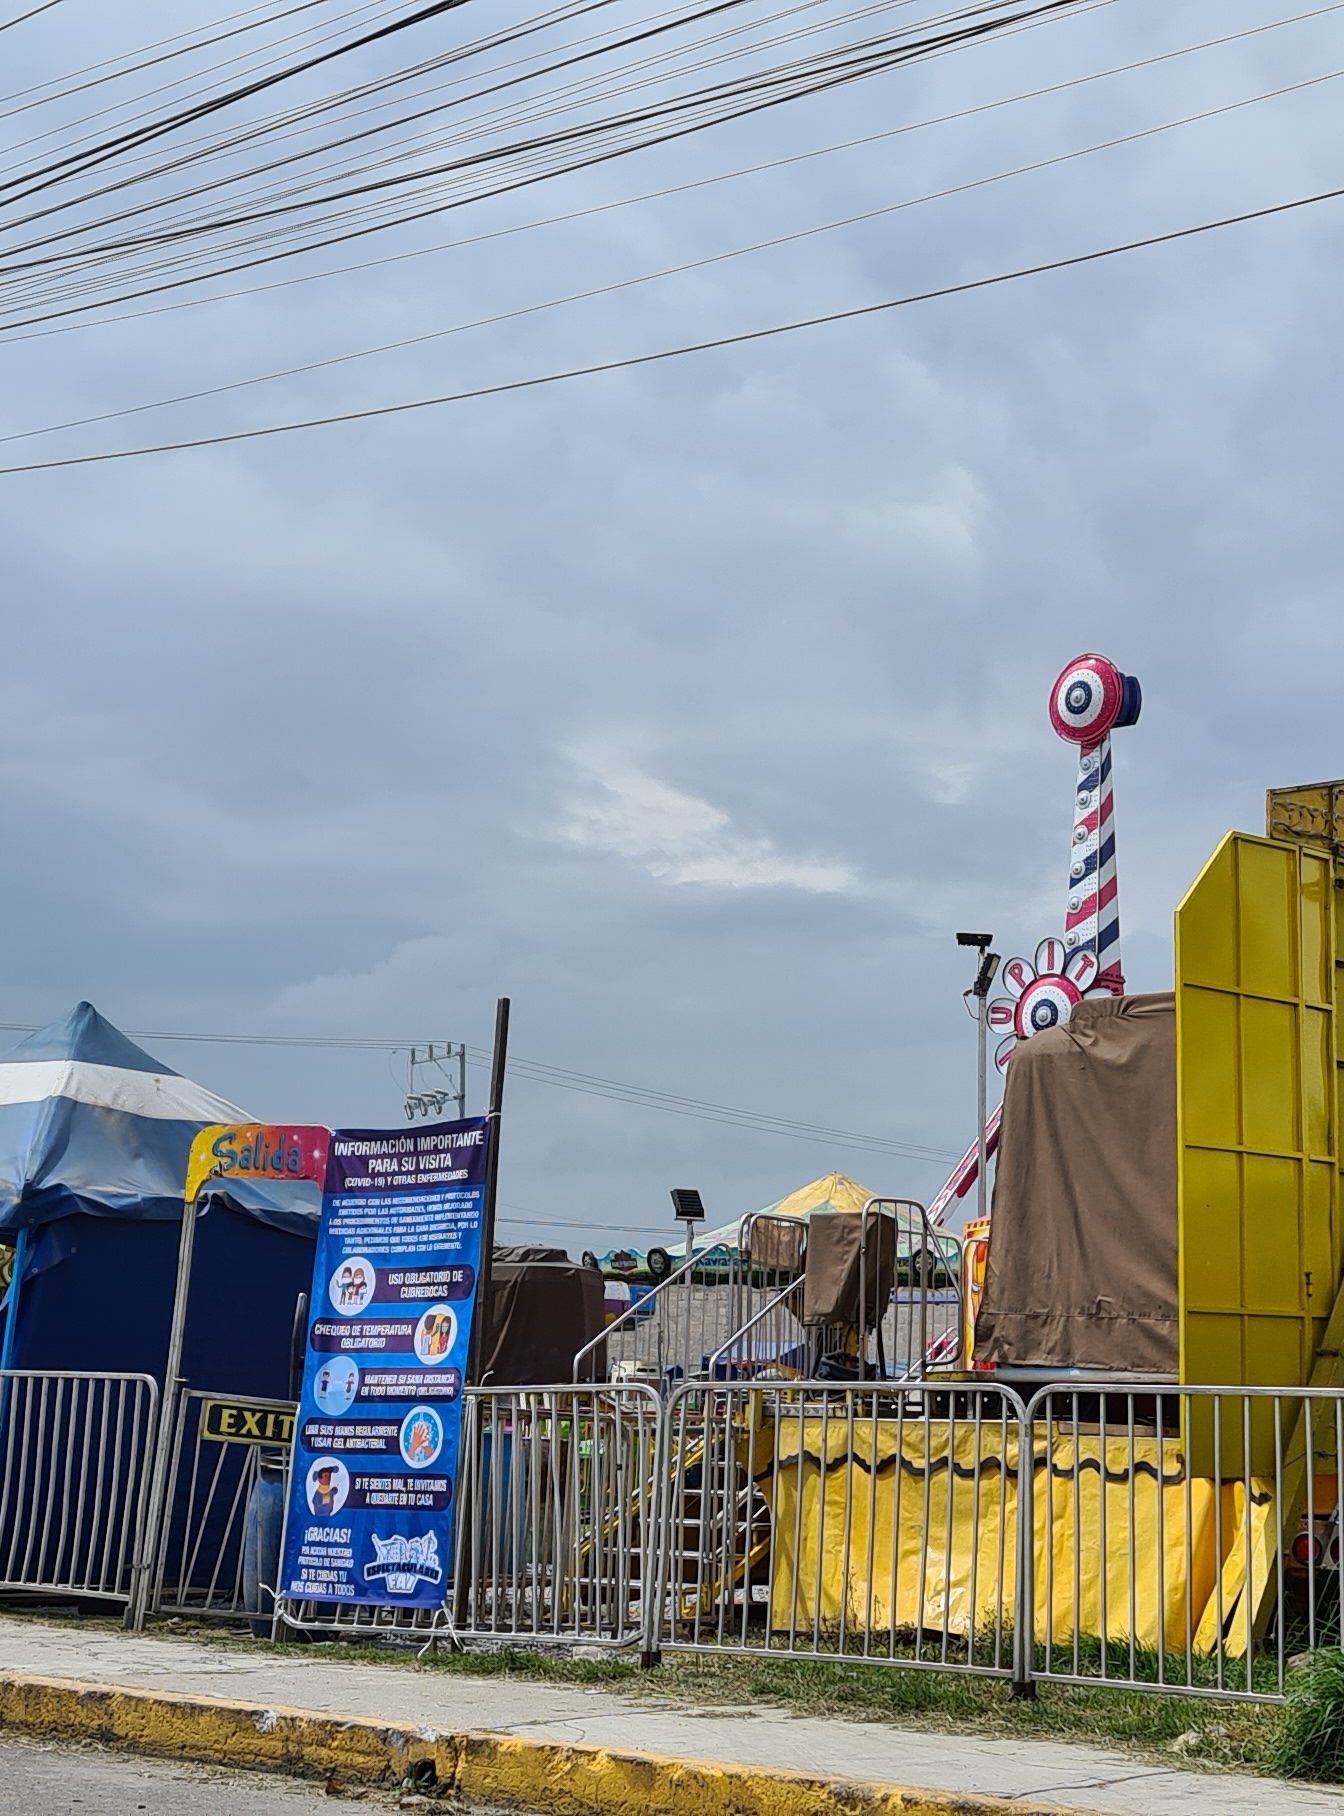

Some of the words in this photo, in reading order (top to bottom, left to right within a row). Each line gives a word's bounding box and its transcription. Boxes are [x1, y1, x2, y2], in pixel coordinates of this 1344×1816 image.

[335, 1136, 414, 1156] INFORMACIÓN
[417, 1131, 483, 1151] IMPORTANTE
[212, 1131, 301, 1173] Salida
[369, 1158, 398, 1173] PARA
[401, 1156, 416, 1172] SU
[419, 1153, 451, 1169] VISITA
[345, 1177, 385, 1188] (COVID-19)
[387, 1177, 391, 1185] Y
[393, 1174, 416, 1185] OTRAS
[418, 1169, 468, 1183] ENFERMEDADES
[388, 1273, 403, 1285] USO
[405, 1271, 450, 1284] OBLIGATORIO
[452, 1271, 463, 1282] DE
[400, 1286, 448, 1298] CUBREBOCAS
[315, 1324, 350, 1335] CHEQUEO
[352, 1325, 362, 1335] DE
[363, 1324, 412, 1336] TEMPERATURA
[341, 1338, 386, 1349] OBLIGATORIO
[219, 1408, 294, 1439] EXIT
[320, 1425, 333, 1435] SUS
[333, 1439, 344, 1448] GEL
[355, 1478, 361, 1489] SI
[362, 1478, 369, 1489] TE
[370, 1478, 391, 1490] SIENTES
[393, 1479, 406, 1492] MAL,
[407, 1479, 414, 1490] TE
[366, 1493, 370, 1504] A
[408, 1494, 415, 1505] TU
[417, 1494, 433, 1506] CASA
[305, 1527, 351, 1544] ¡GRACIAS!
[301, 1569, 307, 1579] SI
[309, 1570, 315, 1580] TE
[366, 1563, 439, 1580] ESPECTACULARES
[328, 1583, 333, 1594] A
[334, 1583, 354, 1596] TODOS
